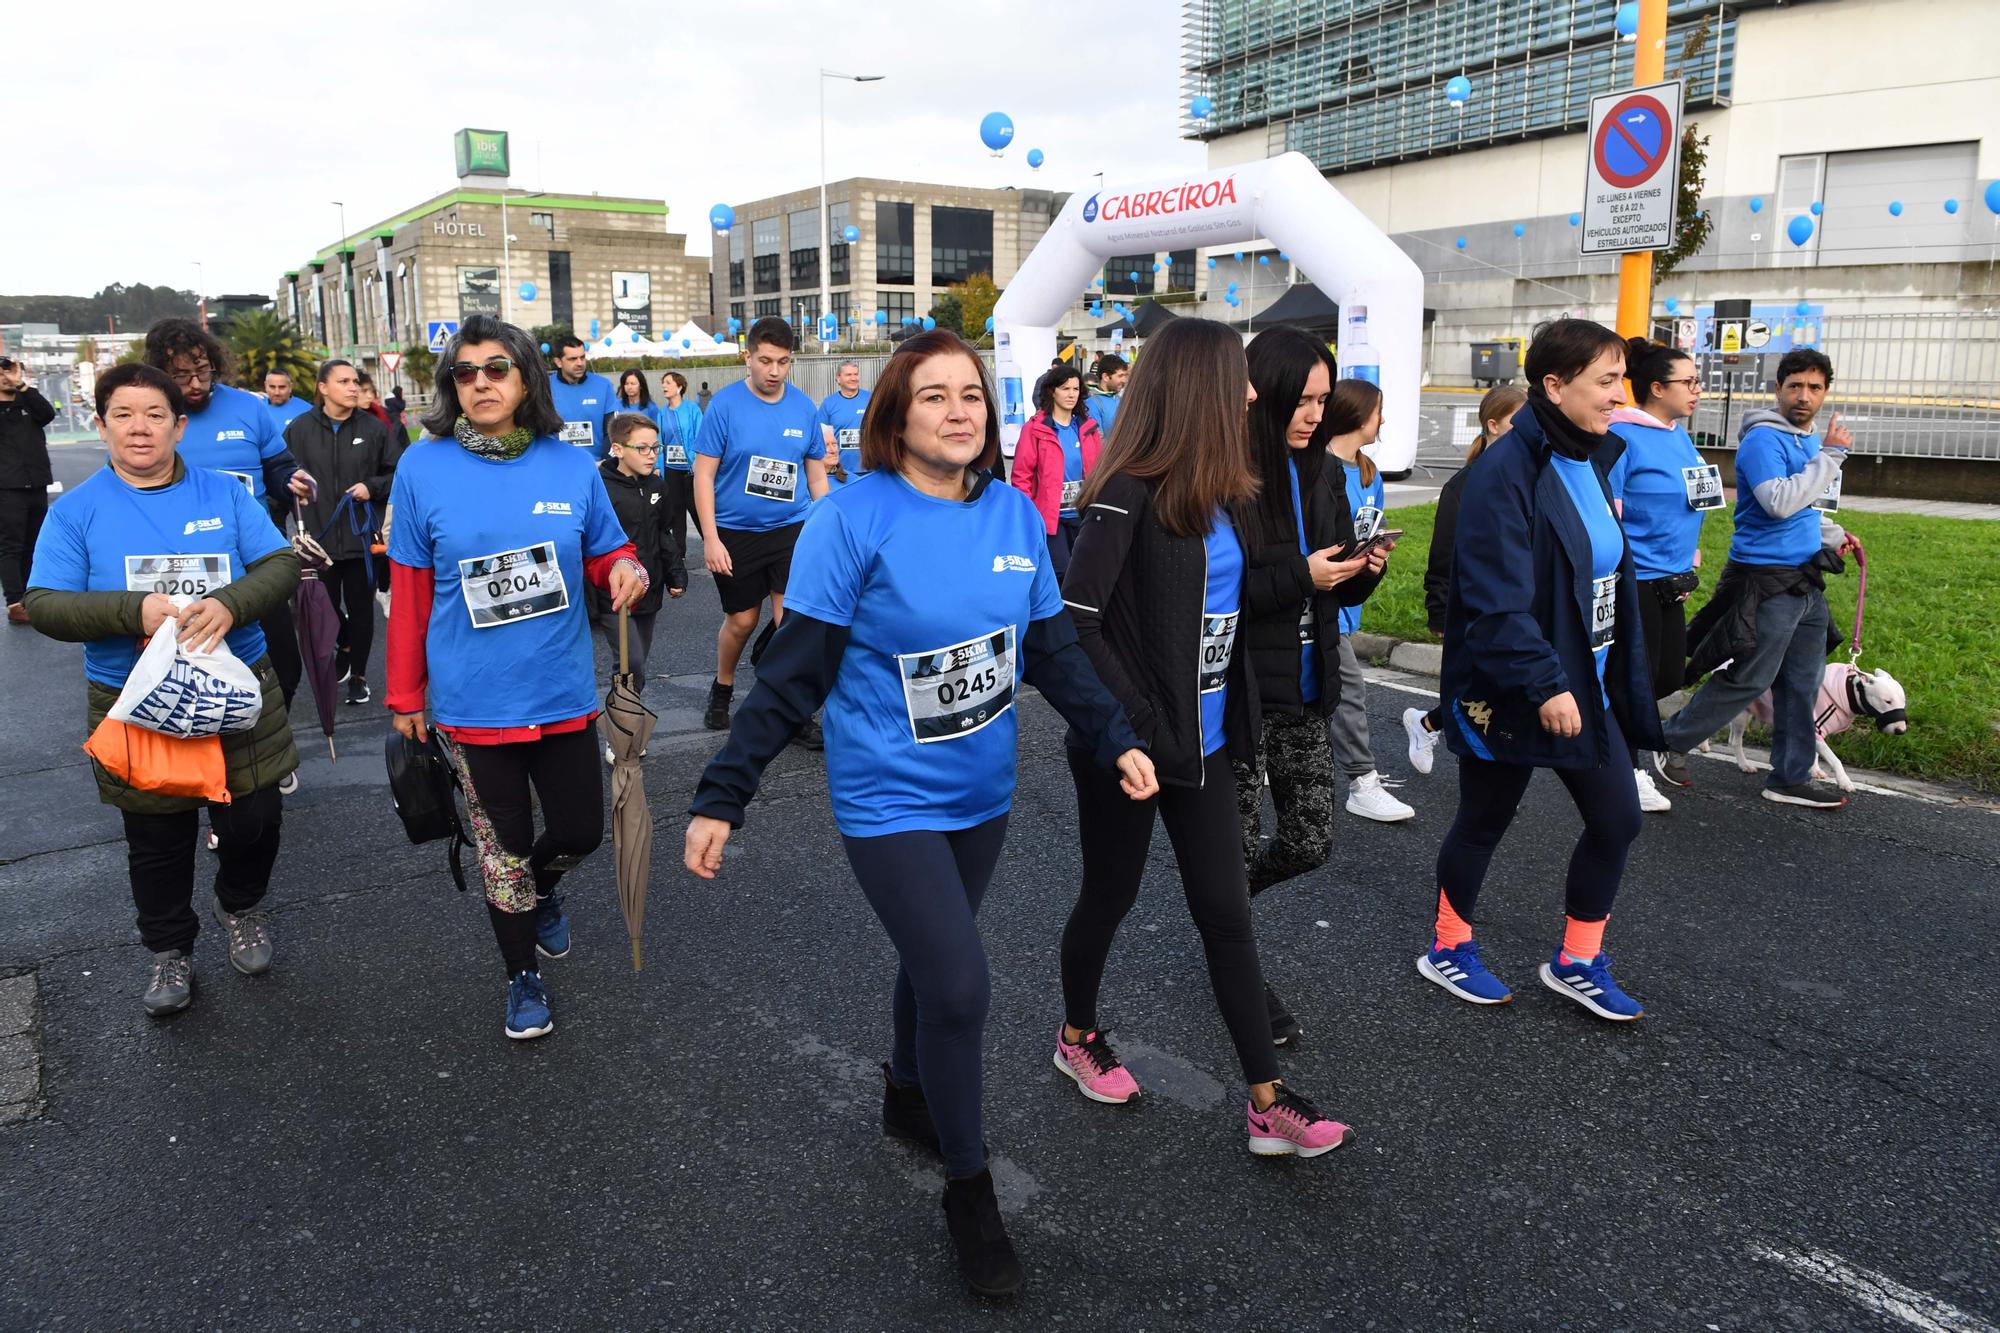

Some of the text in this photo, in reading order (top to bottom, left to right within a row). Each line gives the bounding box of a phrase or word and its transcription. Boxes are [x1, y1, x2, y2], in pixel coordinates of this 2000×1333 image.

[477, 139, 497, 151] ibis
[1102, 173, 1237, 221] CABREÍROÁ
[1597, 188, 1661, 204] DE LUNES A VIERNES
[1610, 205, 1619, 214] DE
[1625, 203, 1630, 212] A
[1631, 202, 1638, 211] 22
[1612, 214, 1642, 225] EXCEPTO
[433, 221, 486, 237] HOTEL
[1124, 230, 1150, 239] Mineral
[1150, 227, 1178, 237] Natural
[1188, 222, 1213, 233] Galicia
[1214, 220, 1225, 230] Sin
[1226, 219, 1242, 228] Gas
[1622, 222, 1667, 235] AUTORIZADOS
[1597, 235, 1655, 249] ESTRELLA GALICIA
[762, 472, 788, 486] 0287
[1696, 482, 1714, 494] 0837
[546, 502, 571, 511] 5KM
[173, 559, 200, 567] 5KM
[502, 552, 528, 565] 5KM
[1006, 555, 1033, 567] 5KM
[153, 579, 207, 596] 0205
[487, 571, 541, 599] 0204
[957, 641, 988, 661] 5KM
[936, 667, 996, 705] 0245
